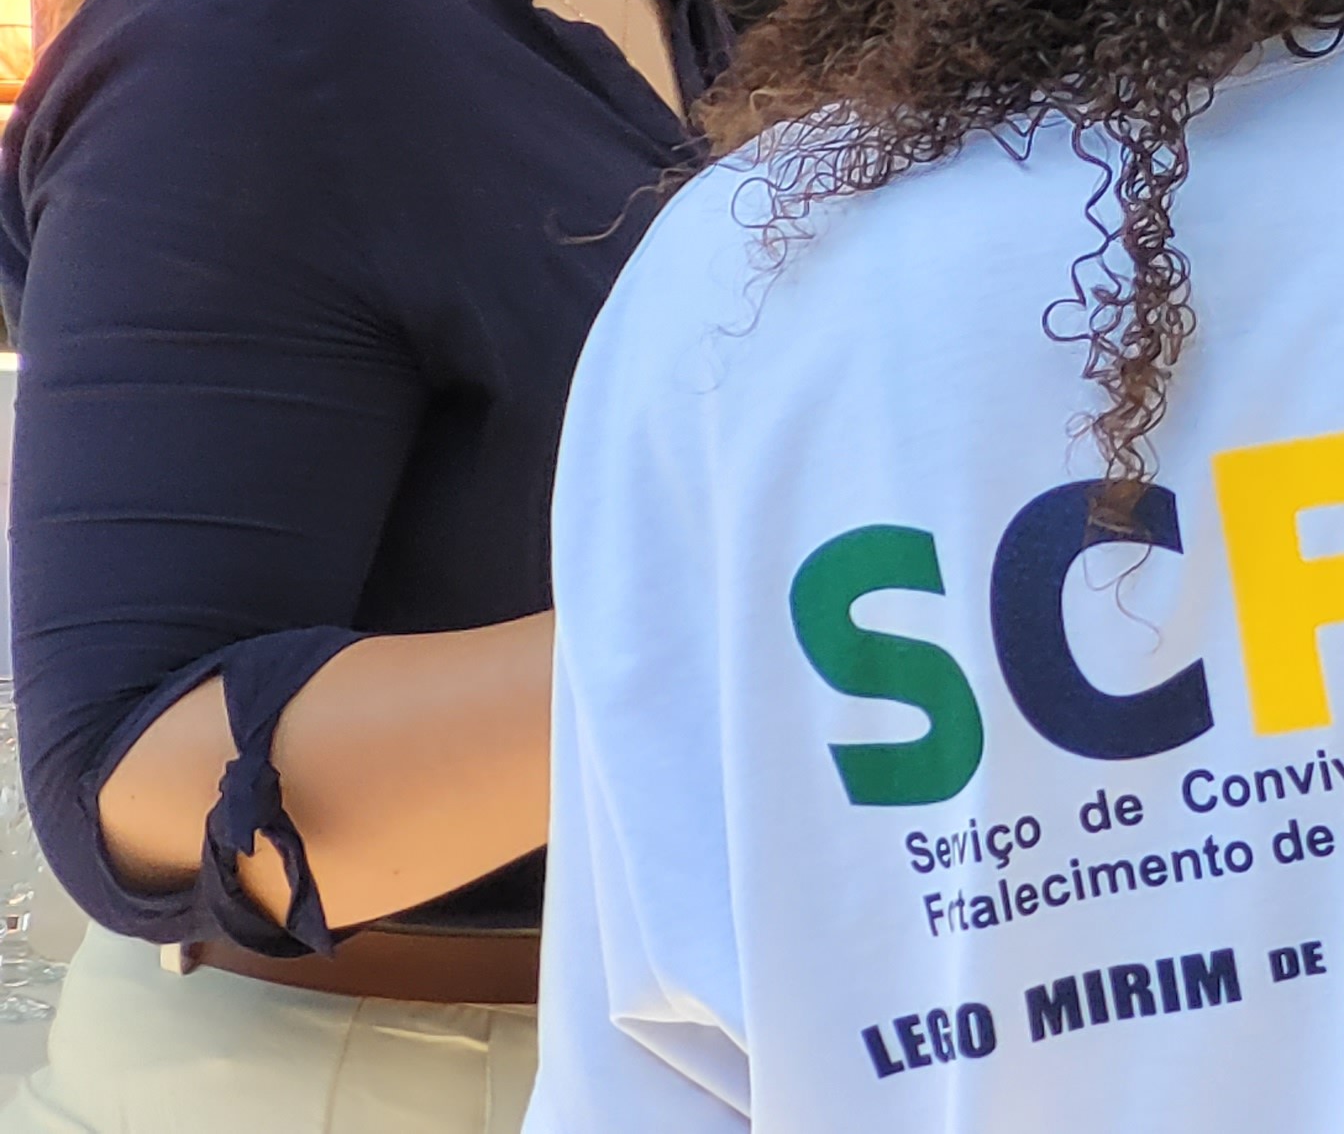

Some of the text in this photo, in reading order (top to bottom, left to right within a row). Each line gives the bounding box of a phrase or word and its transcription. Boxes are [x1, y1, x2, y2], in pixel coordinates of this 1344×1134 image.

[904, 814, 1042, 874] Serviço
[1078, 788, 1144, 834] de
[922, 834, 1254, 937] Frtalecimento
[1272, 818, 1335, 865] de
[1023, 947, 1243, 1043] MIRIM
[1267, 940, 1328, 983] DE
